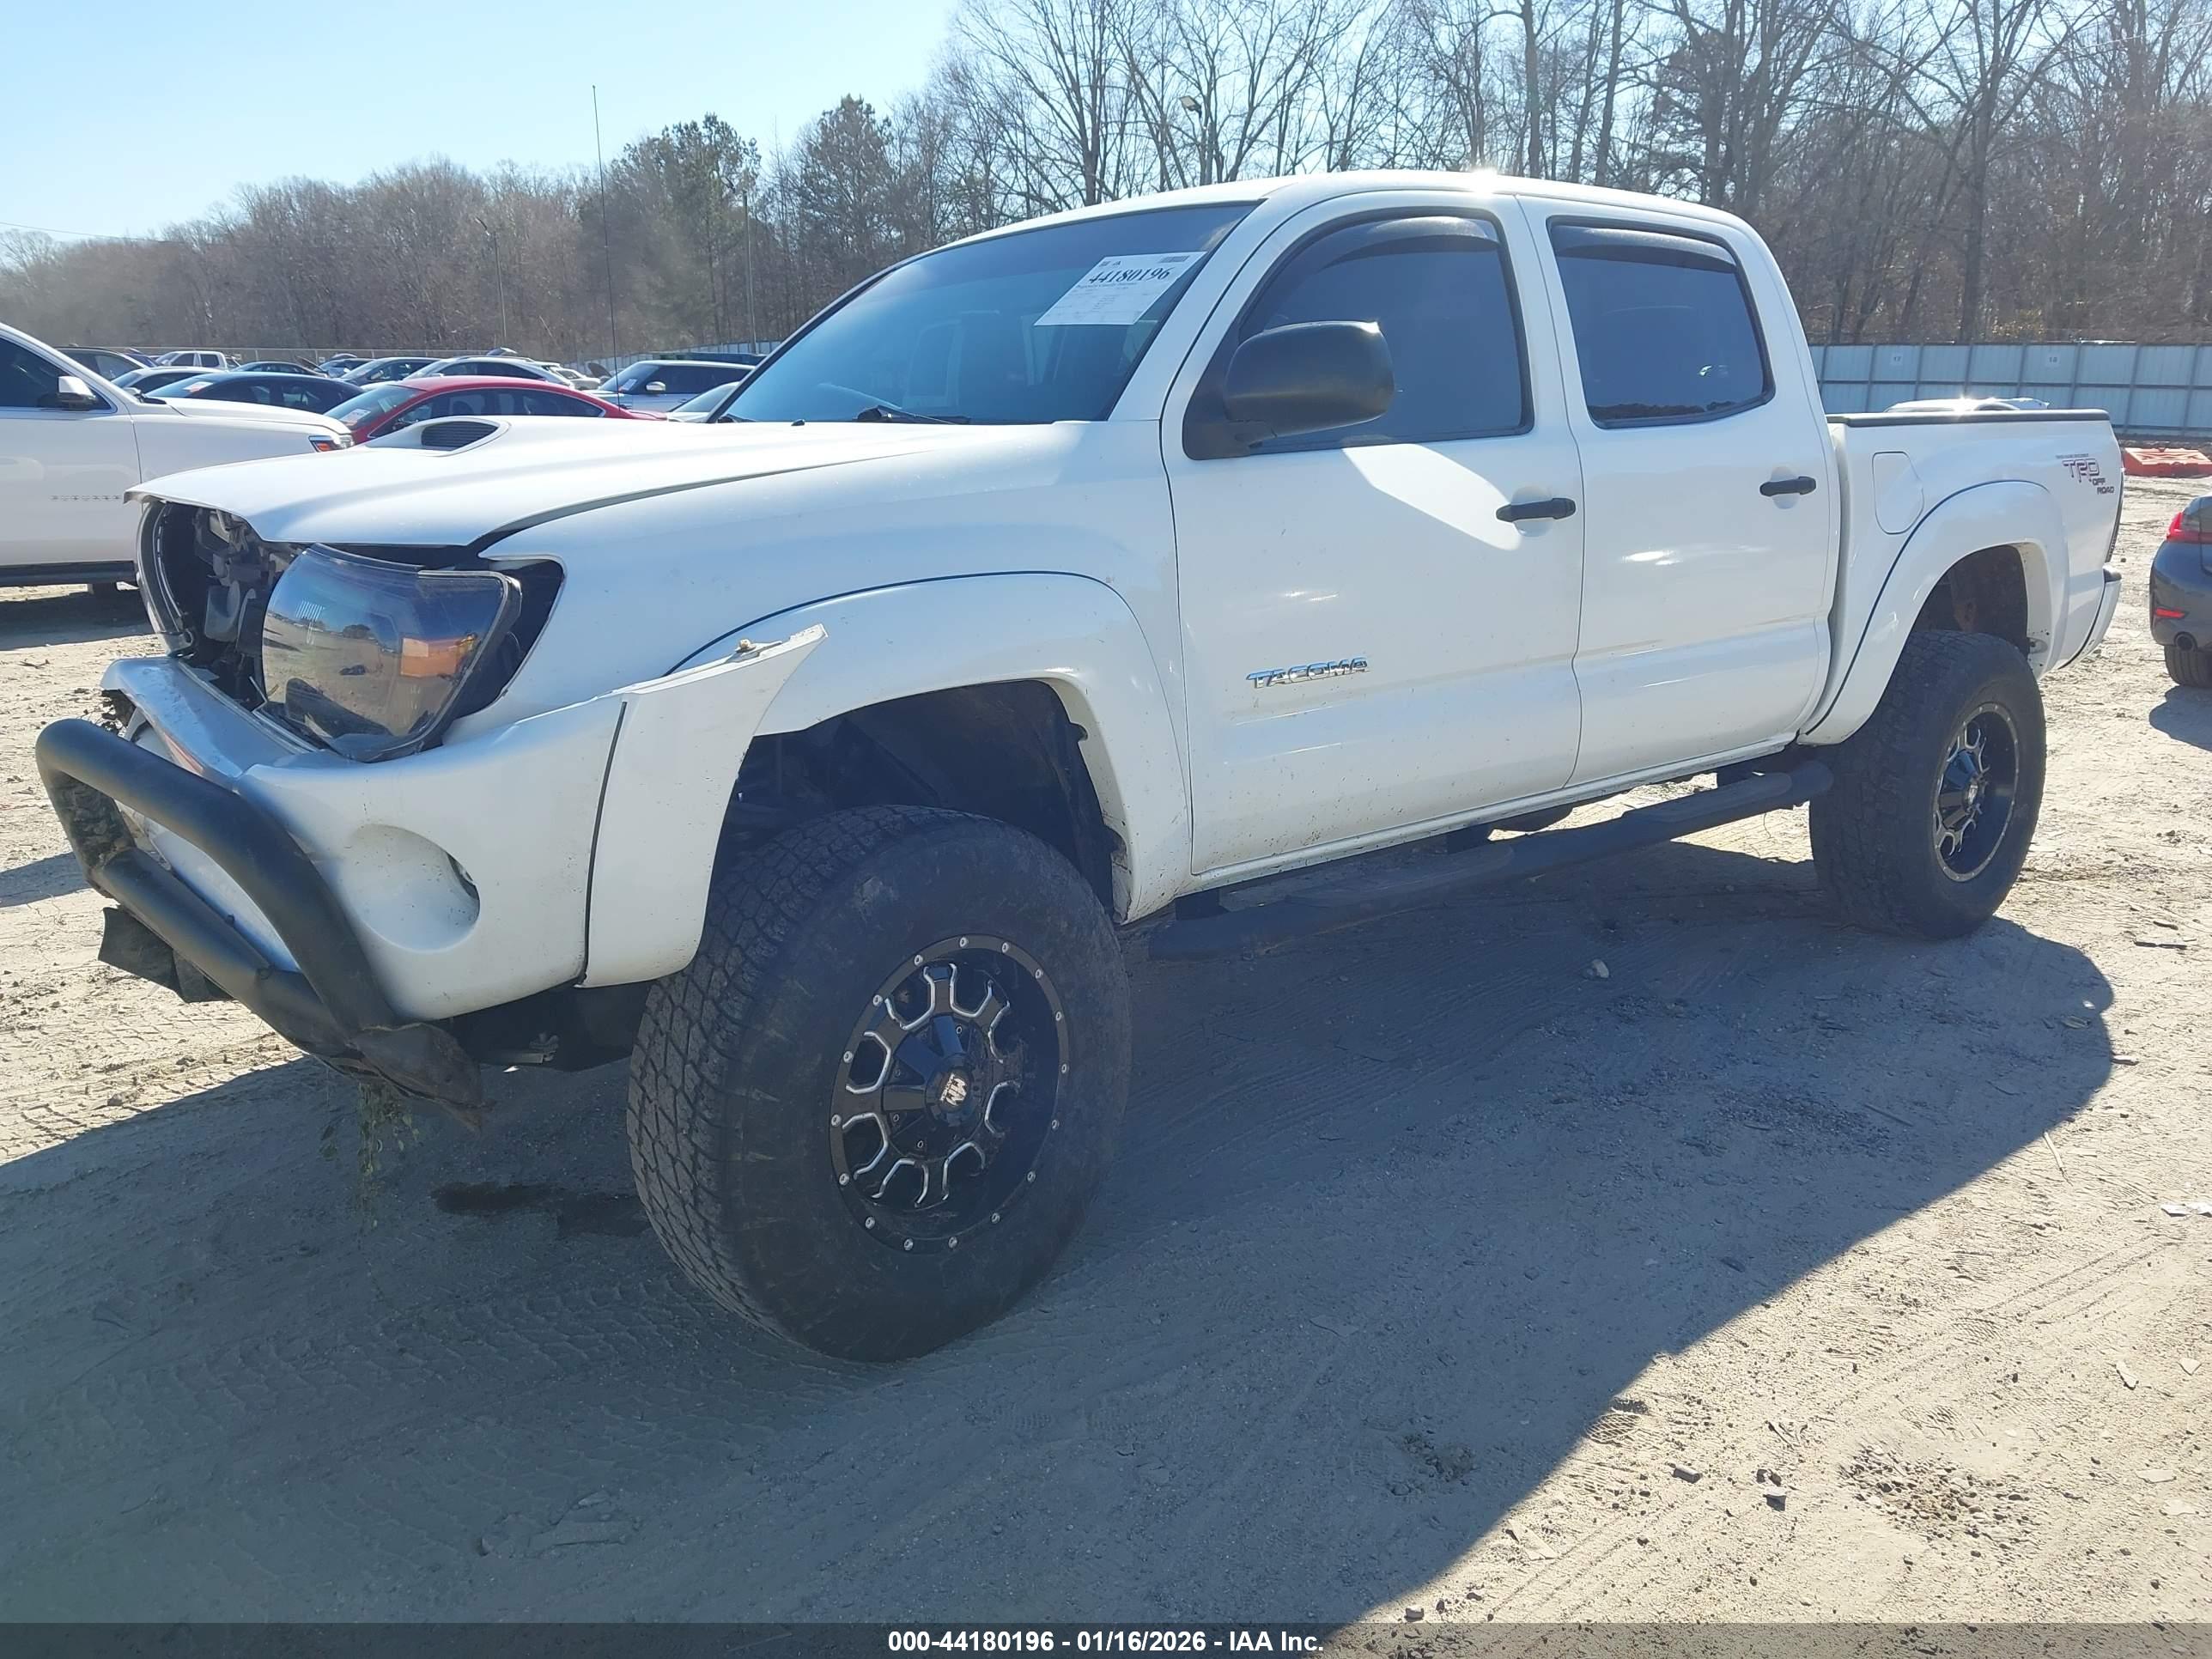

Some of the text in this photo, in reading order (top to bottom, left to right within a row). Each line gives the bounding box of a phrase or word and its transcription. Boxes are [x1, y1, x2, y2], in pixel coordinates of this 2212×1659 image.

[1089, 267, 1175, 283] 44180196
[2062, 459, 2100, 483] TRD
[2097, 486, 2115, 495] ROAD
[1246, 656, 1368, 689] TACOMA
